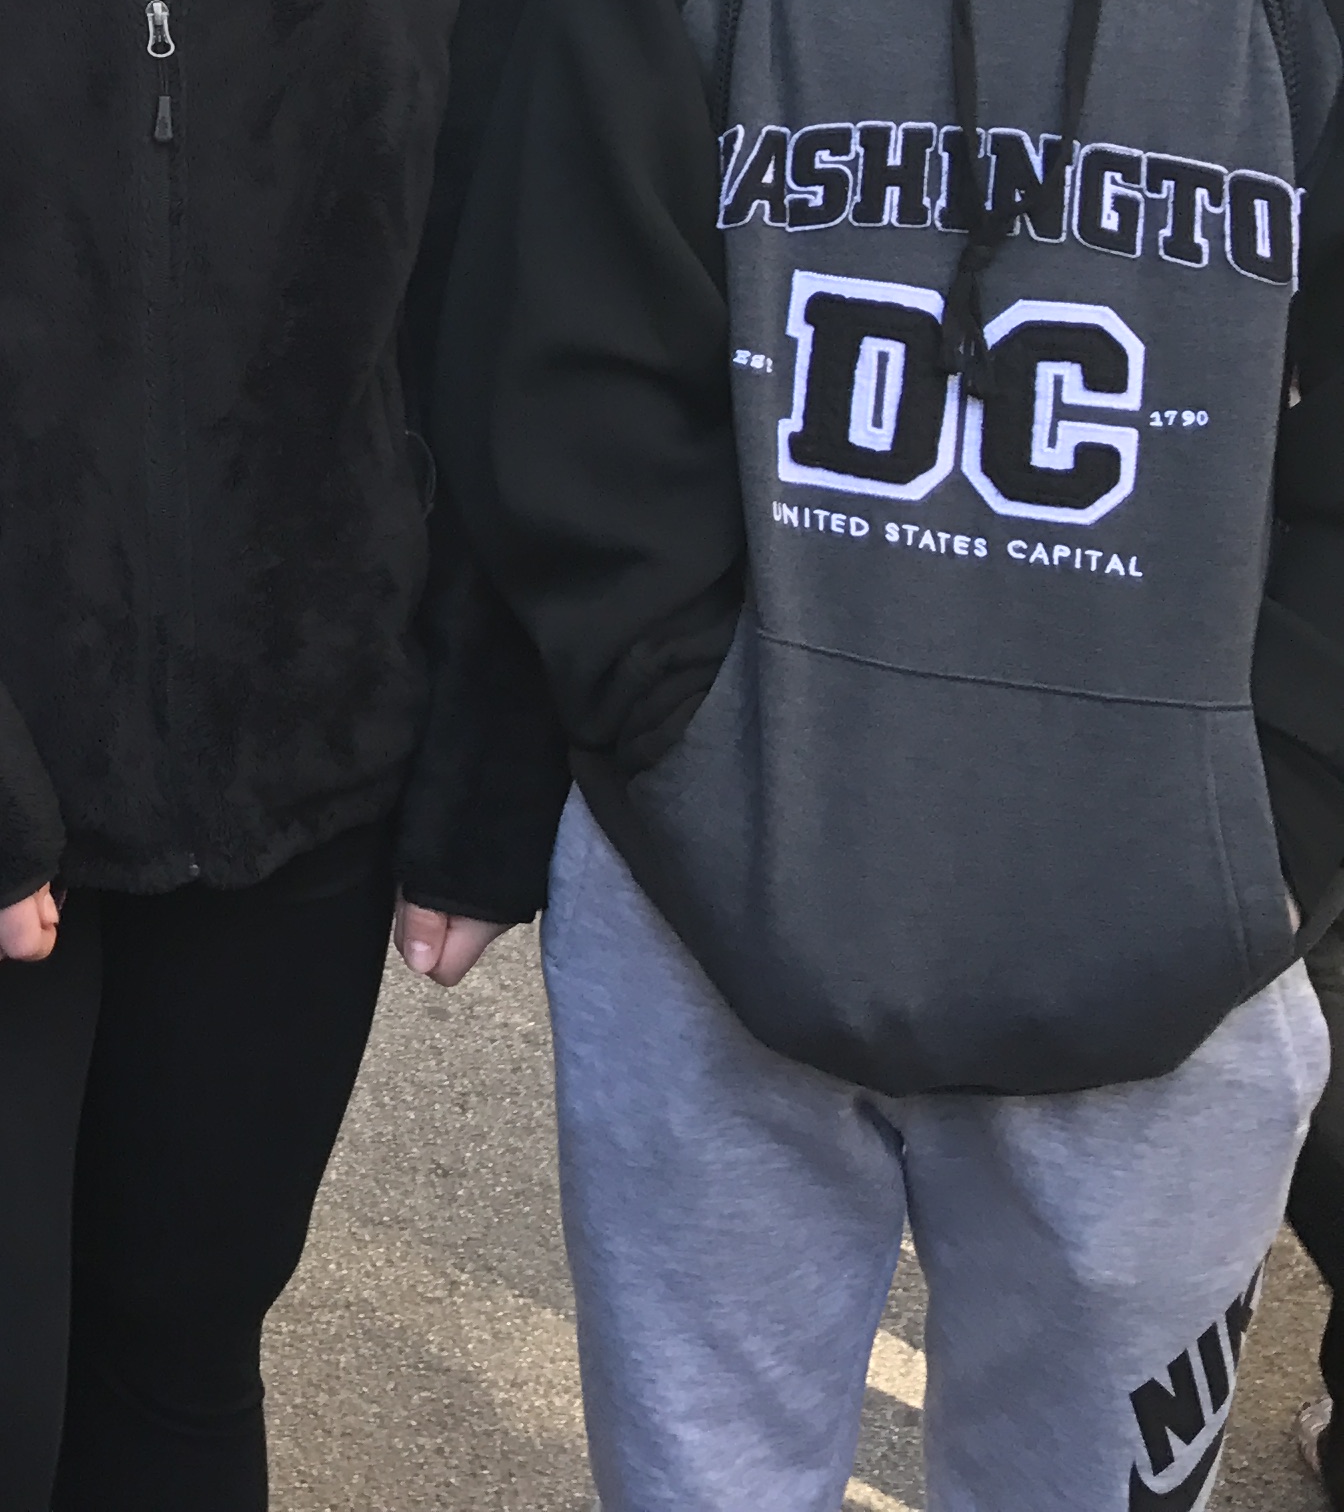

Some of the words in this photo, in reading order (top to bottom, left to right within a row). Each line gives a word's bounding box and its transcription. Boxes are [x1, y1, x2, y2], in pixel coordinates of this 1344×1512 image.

[717, 121, 1307, 292] ASHINGTO
[778, 269, 1146, 526] DC
[1150, 409, 1209, 428] 1790
[772, 500, 870, 539] UNITED
[884, 521, 989, 559] STATES
[1006, 538, 1144, 578] CAPITAL
[1129, 1245, 1272, 1477] NIK
